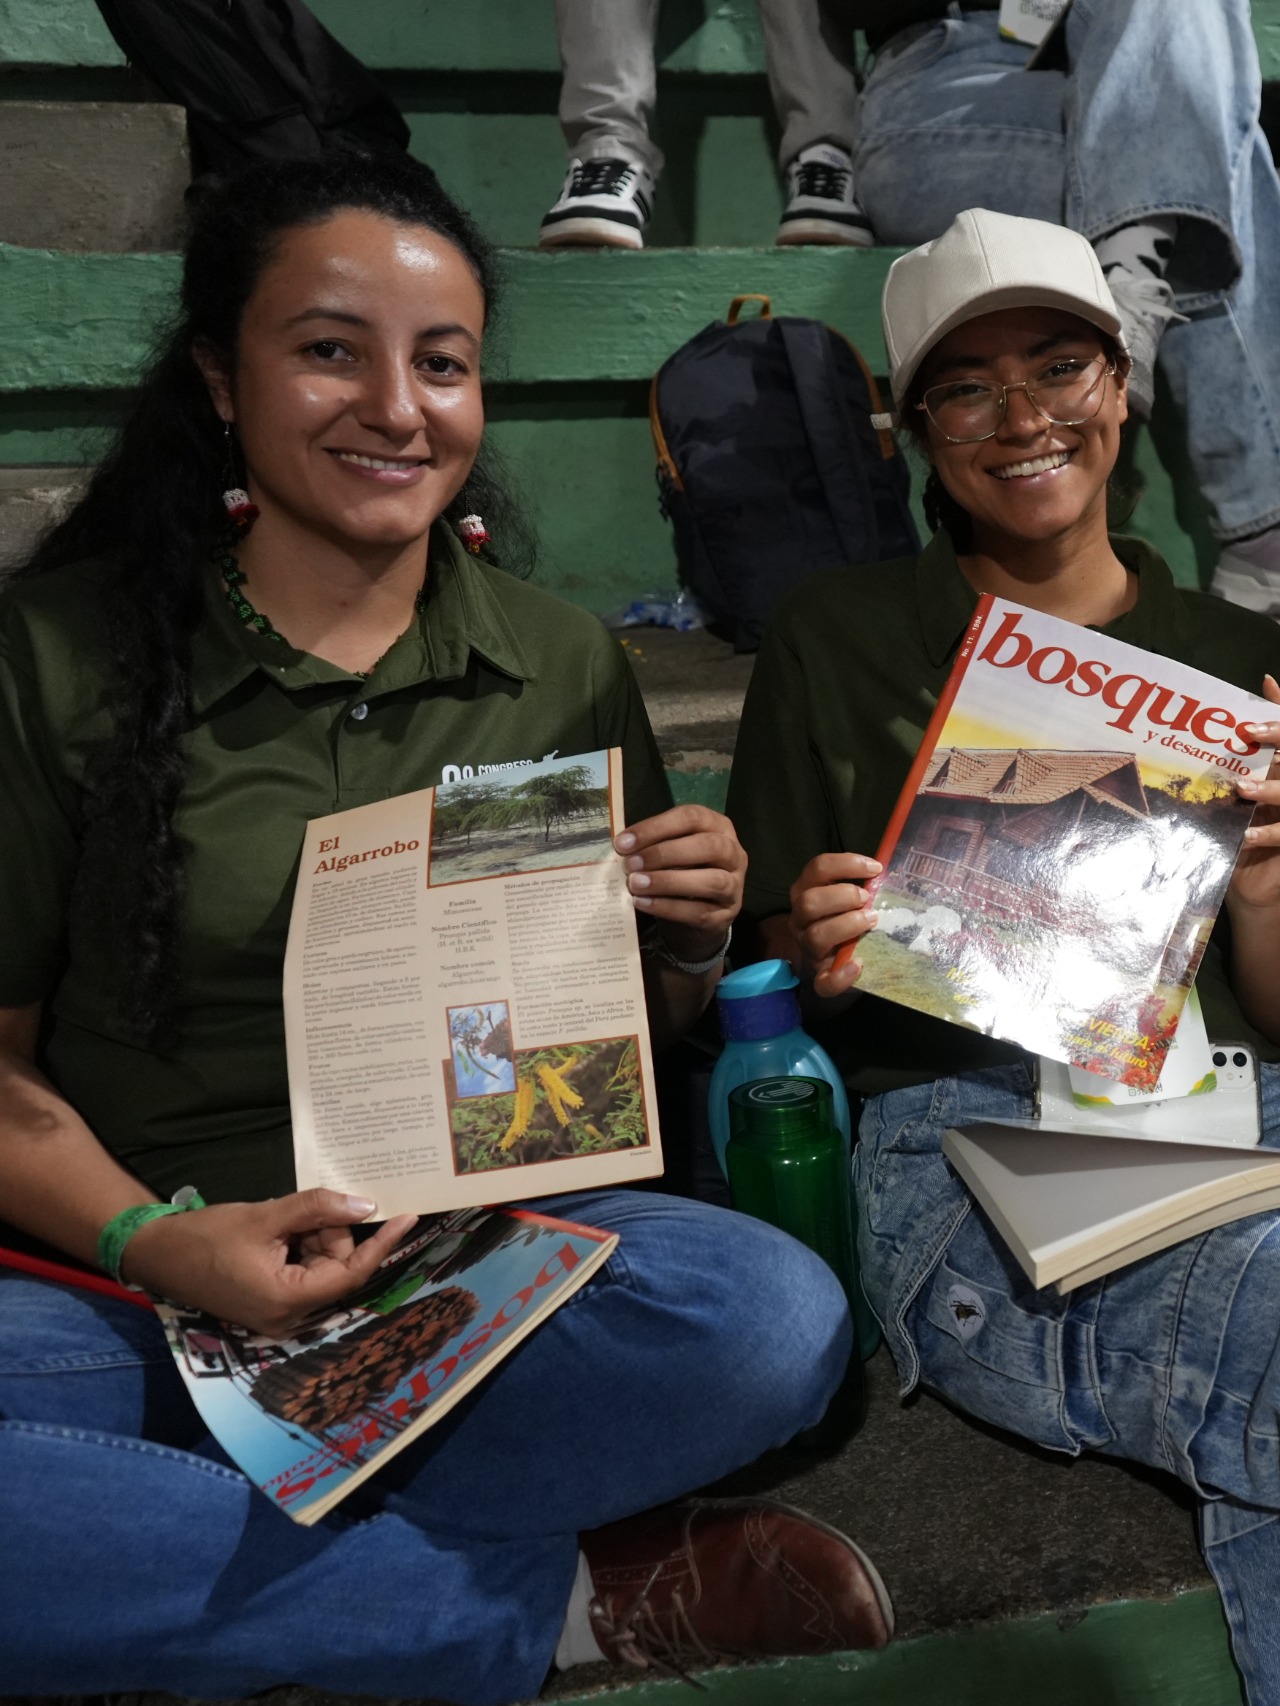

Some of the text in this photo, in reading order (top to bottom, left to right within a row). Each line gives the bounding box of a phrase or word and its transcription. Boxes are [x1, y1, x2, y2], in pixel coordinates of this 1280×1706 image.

[977, 612, 1260, 756] bosques
[1143, 730, 1251, 776] y desarrollo
[313, 840, 420, 875] Algarrobo
[317, 836, 340, 854] El
[431, 924, 460, 934] Nombre
[1110, 1047, 1148, 1068] futuro
[276, 1241, 583, 1507] bosques
